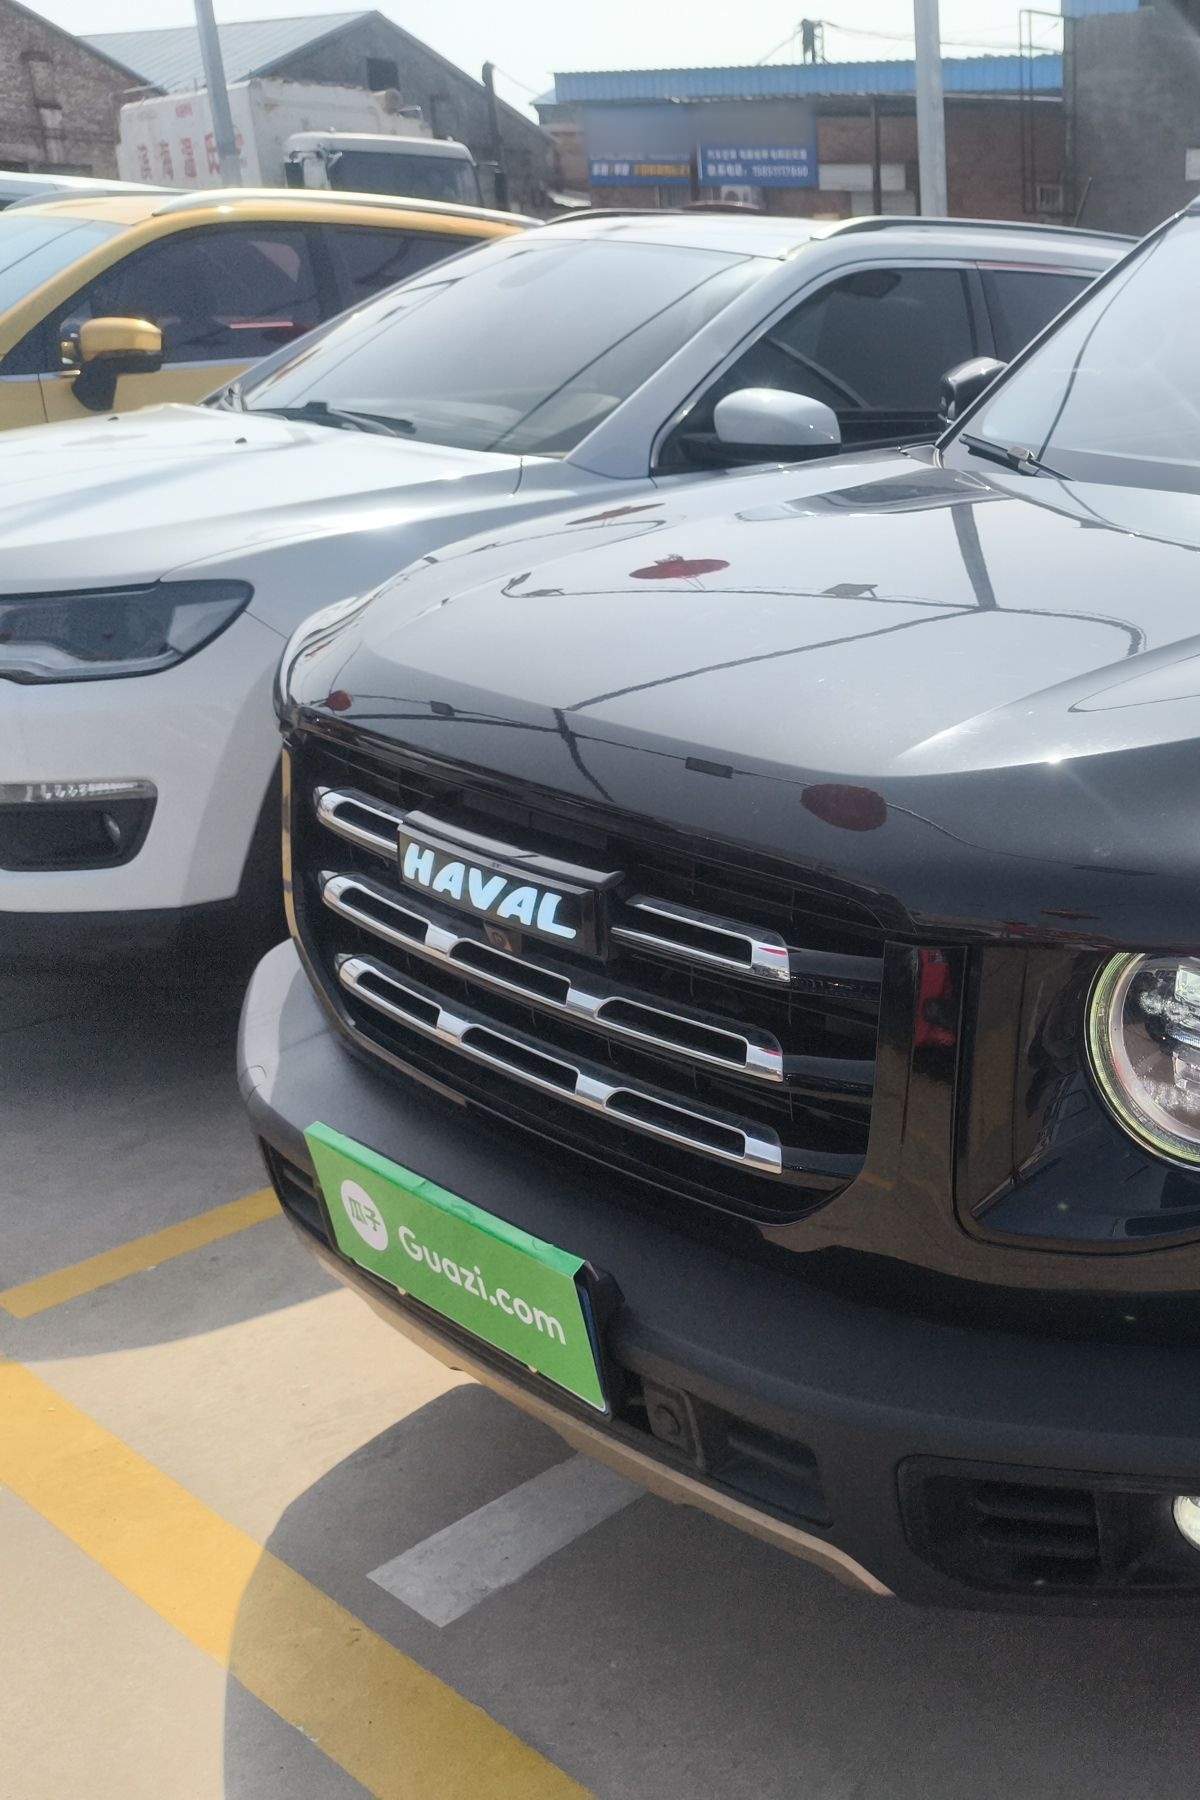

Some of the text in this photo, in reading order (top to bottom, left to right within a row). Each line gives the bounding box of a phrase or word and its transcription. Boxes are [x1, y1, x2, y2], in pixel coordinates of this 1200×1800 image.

[403, 842, 577, 939] HAVAL
[348, 1196, 381, 1232] 瓜子
[398, 1225, 566, 1345] Guazi.com
